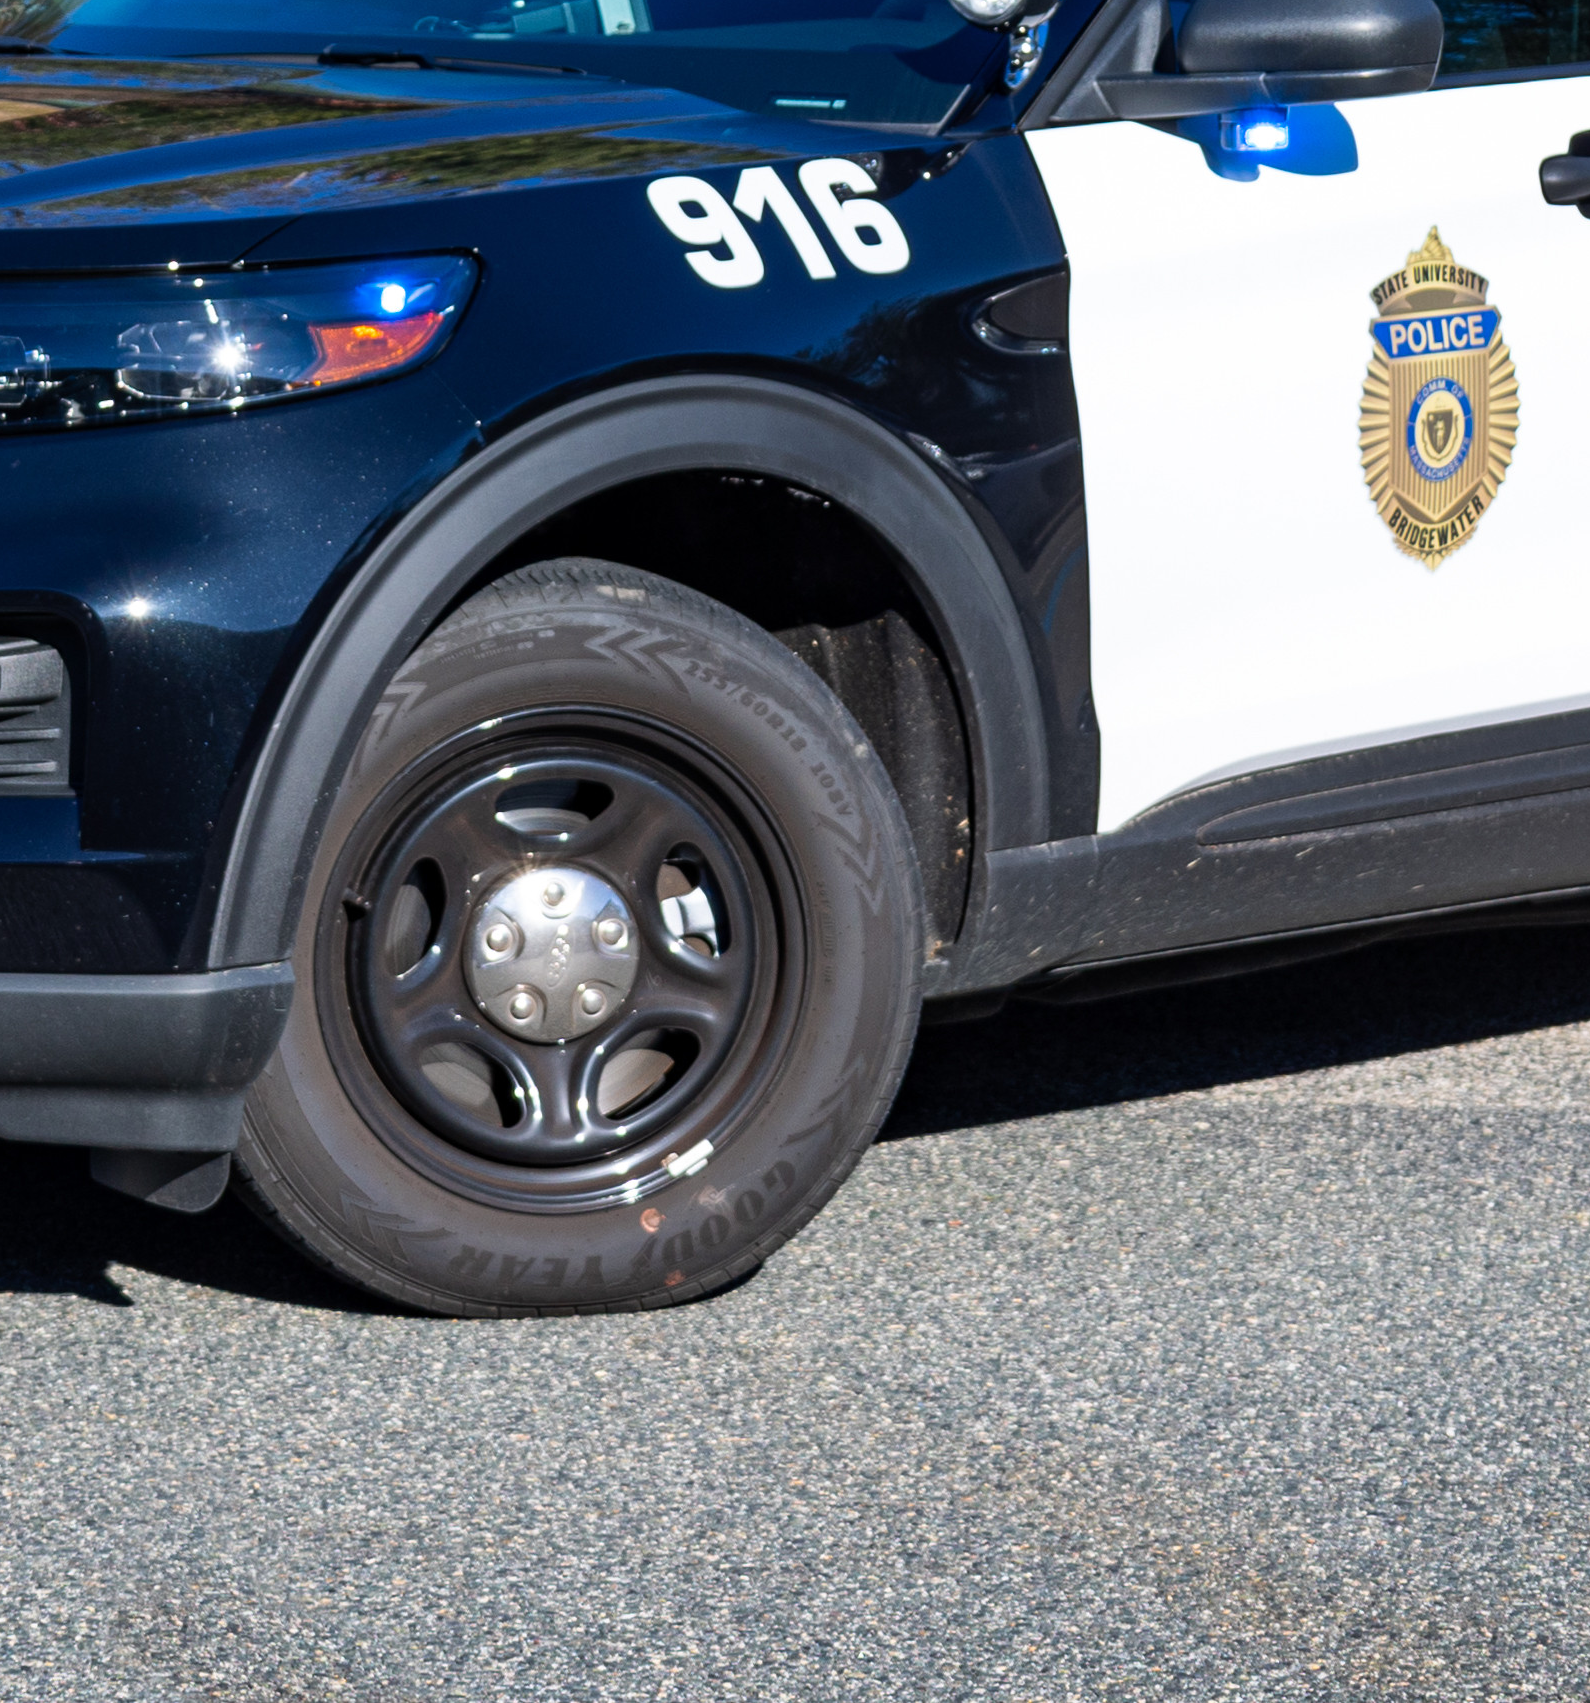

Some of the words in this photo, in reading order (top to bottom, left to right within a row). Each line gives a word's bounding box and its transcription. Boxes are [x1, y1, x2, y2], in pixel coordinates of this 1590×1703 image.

[646, 158, 911, 289] 916
[1372, 269, 1409, 306] STATE
[1413, 264, 1486, 295] UNIVERSITY
[1389, 314, 1485, 356] POLICE
[1388, 495, 1485, 550] BRIDGEWATER
